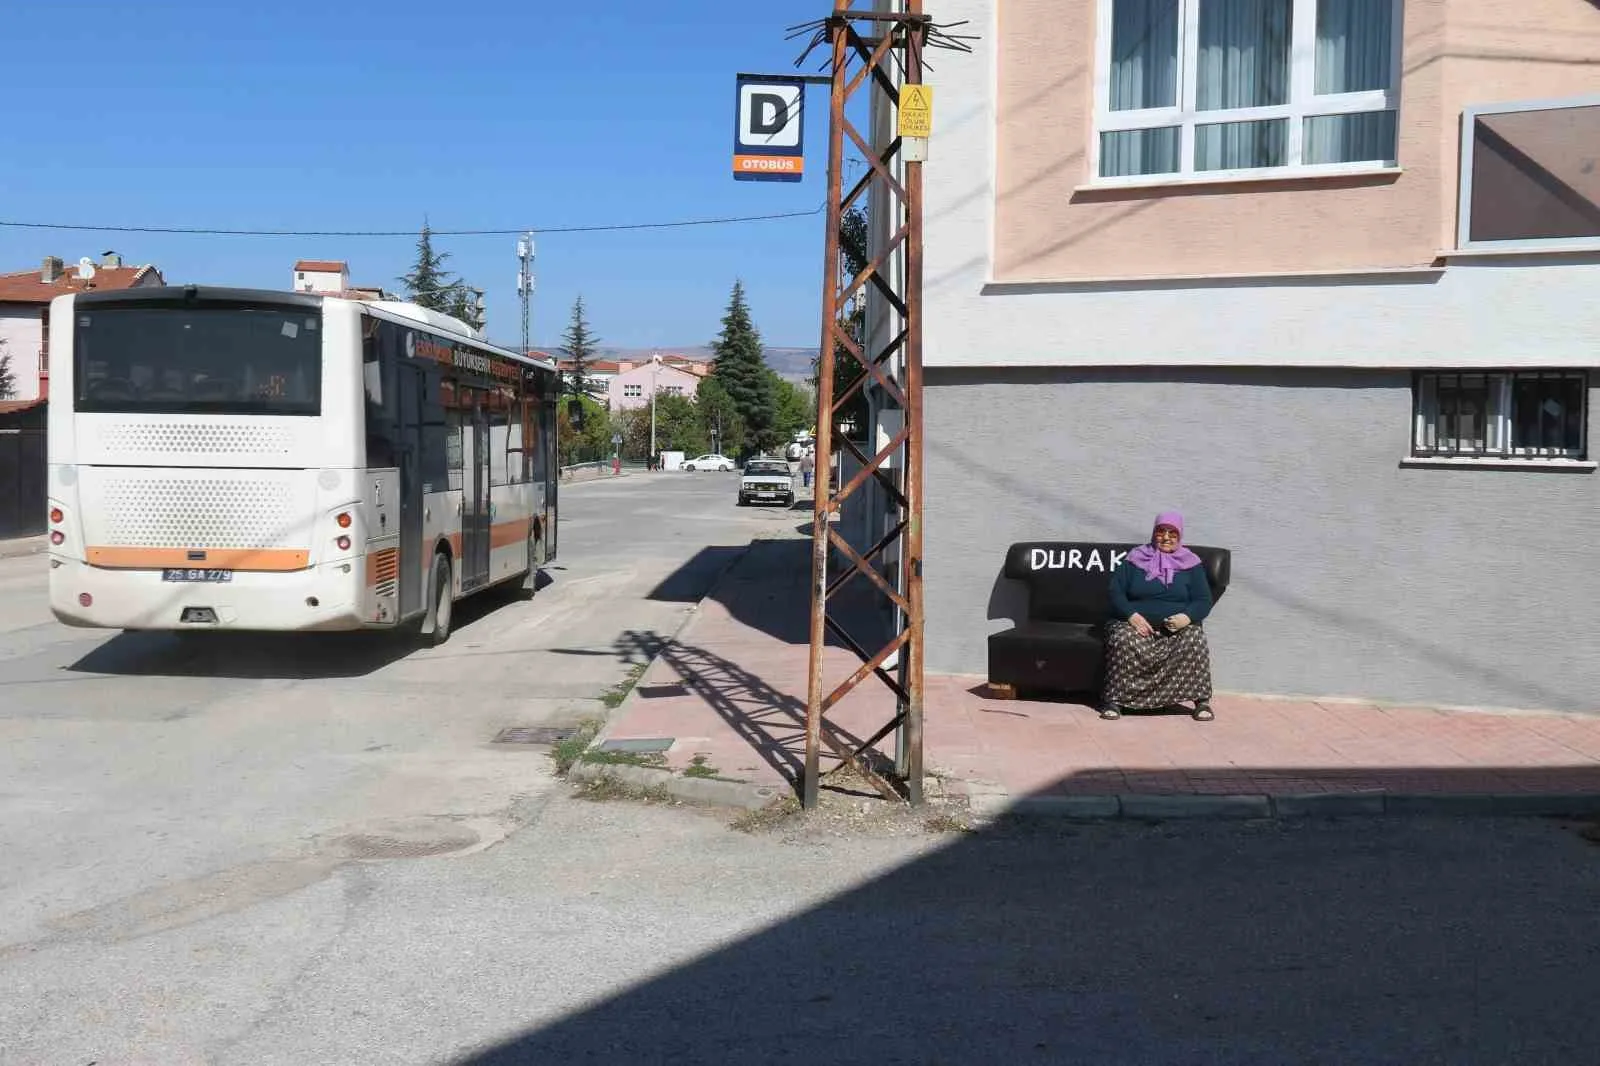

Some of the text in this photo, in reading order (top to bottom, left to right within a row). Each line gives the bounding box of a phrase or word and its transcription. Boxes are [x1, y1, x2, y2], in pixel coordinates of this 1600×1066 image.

[750, 93, 788, 134] D
[742, 158, 794, 170] OTOBÜS
[1031, 549, 1127, 573] DURAK
